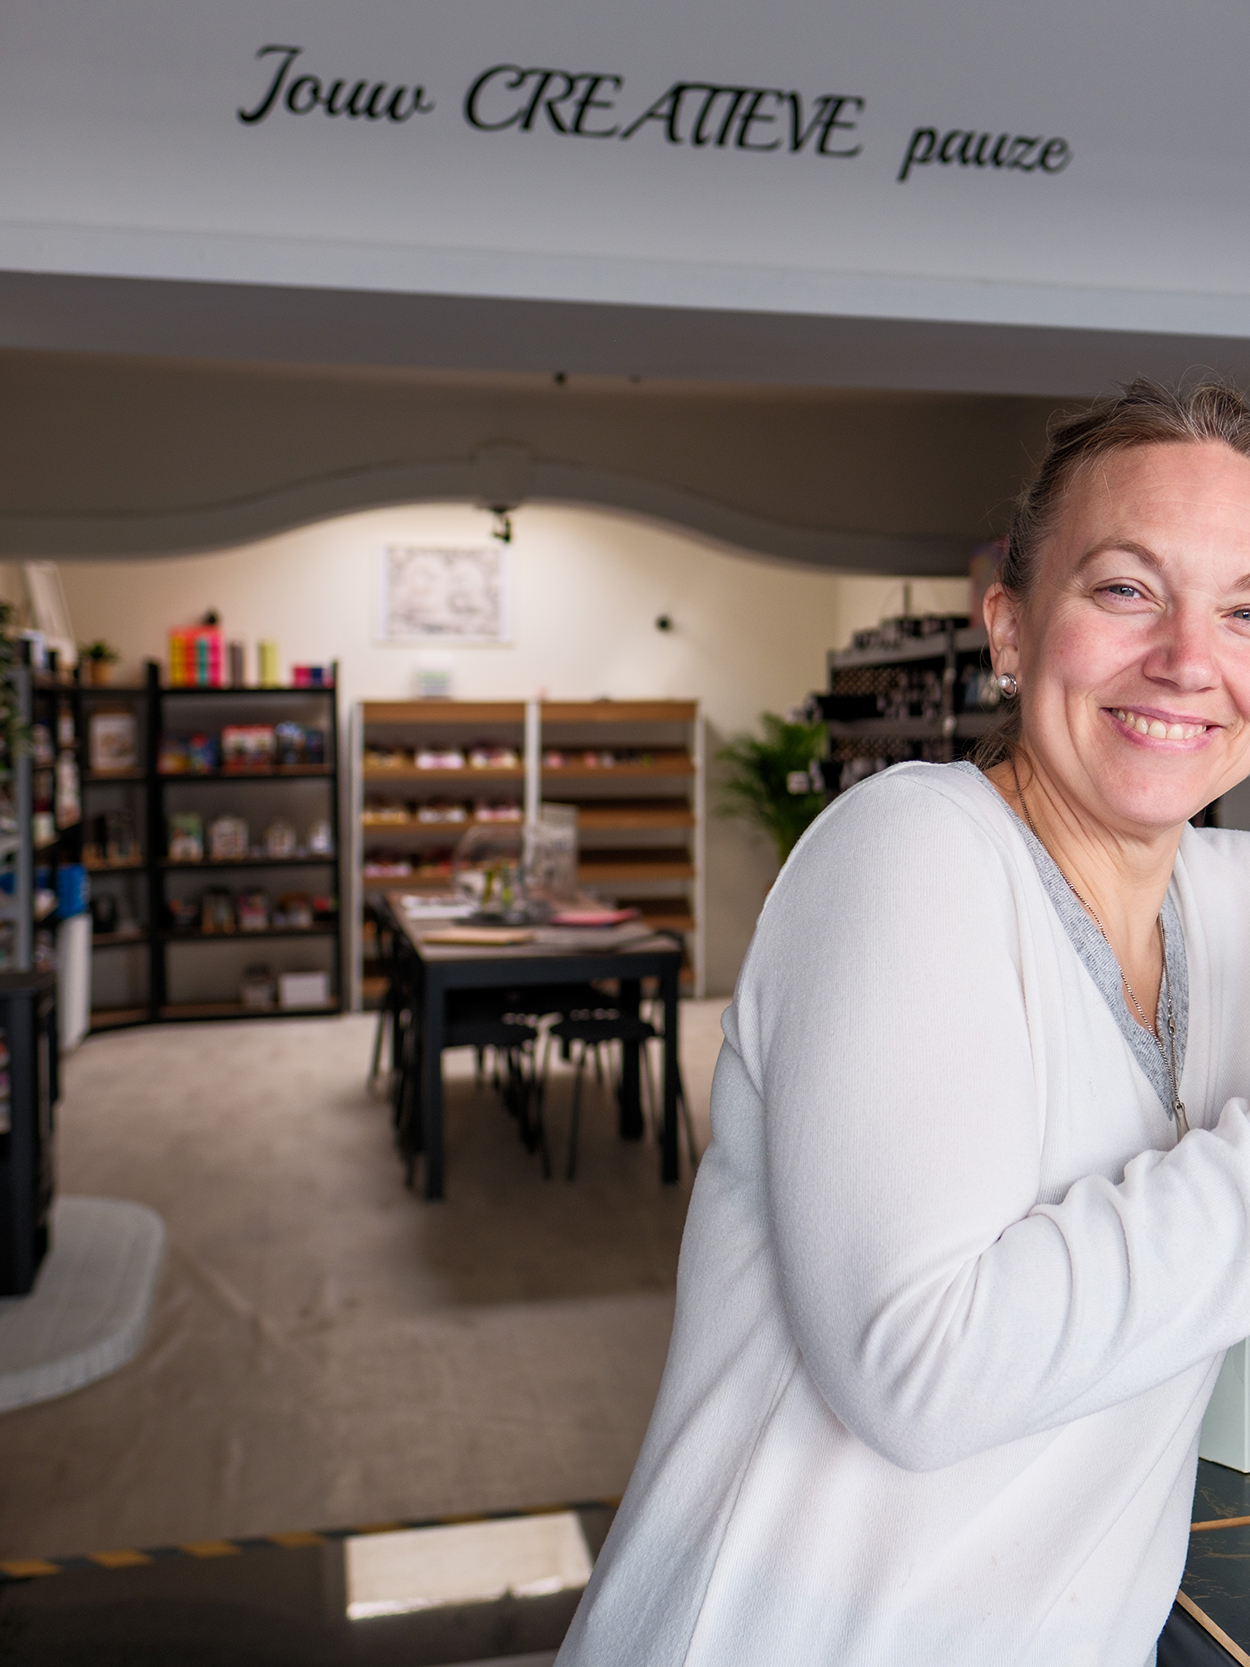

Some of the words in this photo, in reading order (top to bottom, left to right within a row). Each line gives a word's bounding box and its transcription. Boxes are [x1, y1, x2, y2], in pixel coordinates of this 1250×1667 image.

[237, 45, 434, 127] Jouw
[464, 63, 866, 158] CREATIEVE
[896, 124, 1074, 183] pauze
